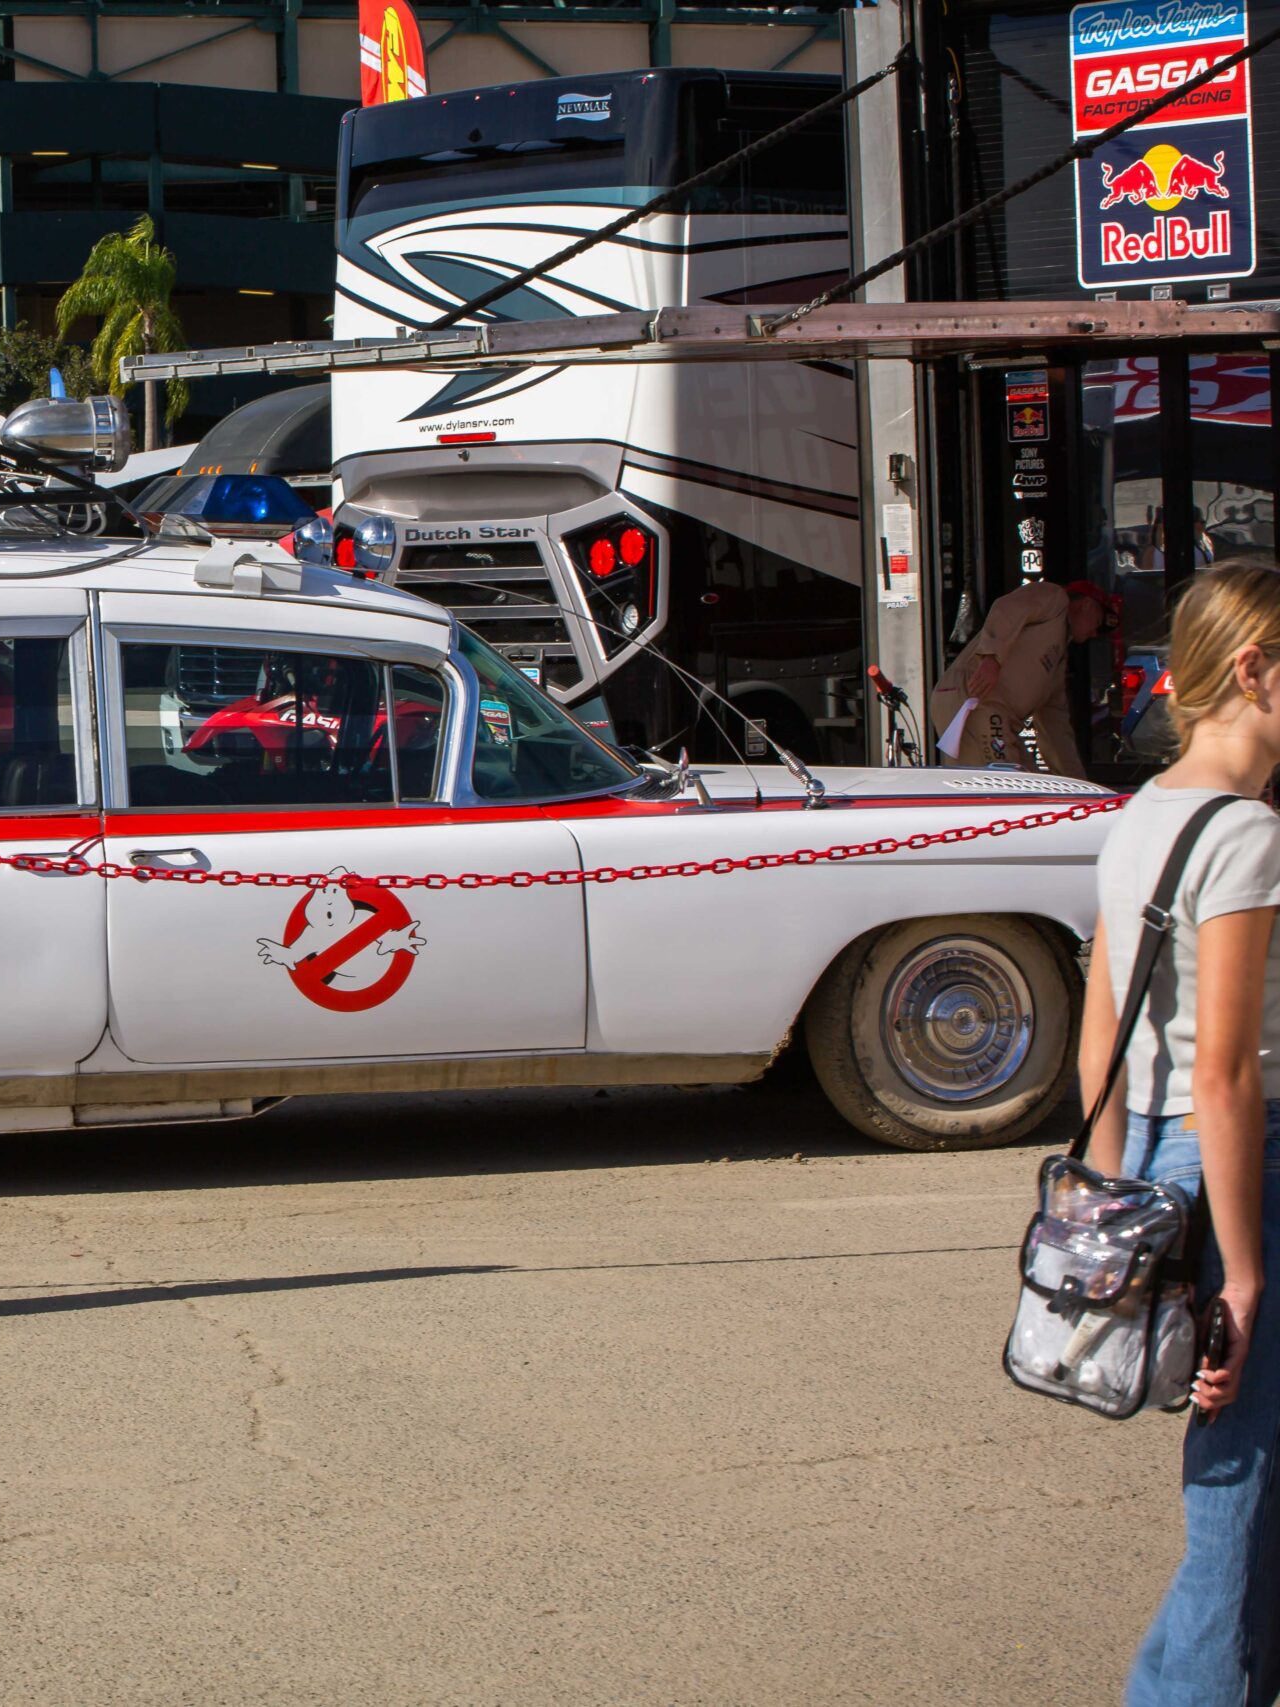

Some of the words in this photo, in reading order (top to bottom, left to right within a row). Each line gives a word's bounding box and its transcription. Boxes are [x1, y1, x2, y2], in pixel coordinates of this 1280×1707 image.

[1079, 12, 1118, 47] Troy
[1118, 8, 1154, 42] Lee
[1154, 1, 1239, 36] Designs
[557, 101, 611, 115] NEWMAR
[1100, 215, 1166, 266] Red
[1166, 209, 1232, 261] Bull
[418, 416, 516, 434] www.dylansrv.com
[1020, 447, 1038, 458] SONY
[1015, 458, 1046, 470] PICTURES
[405, 526, 471, 542] Dutch
[479, 525, 536, 539] Star
